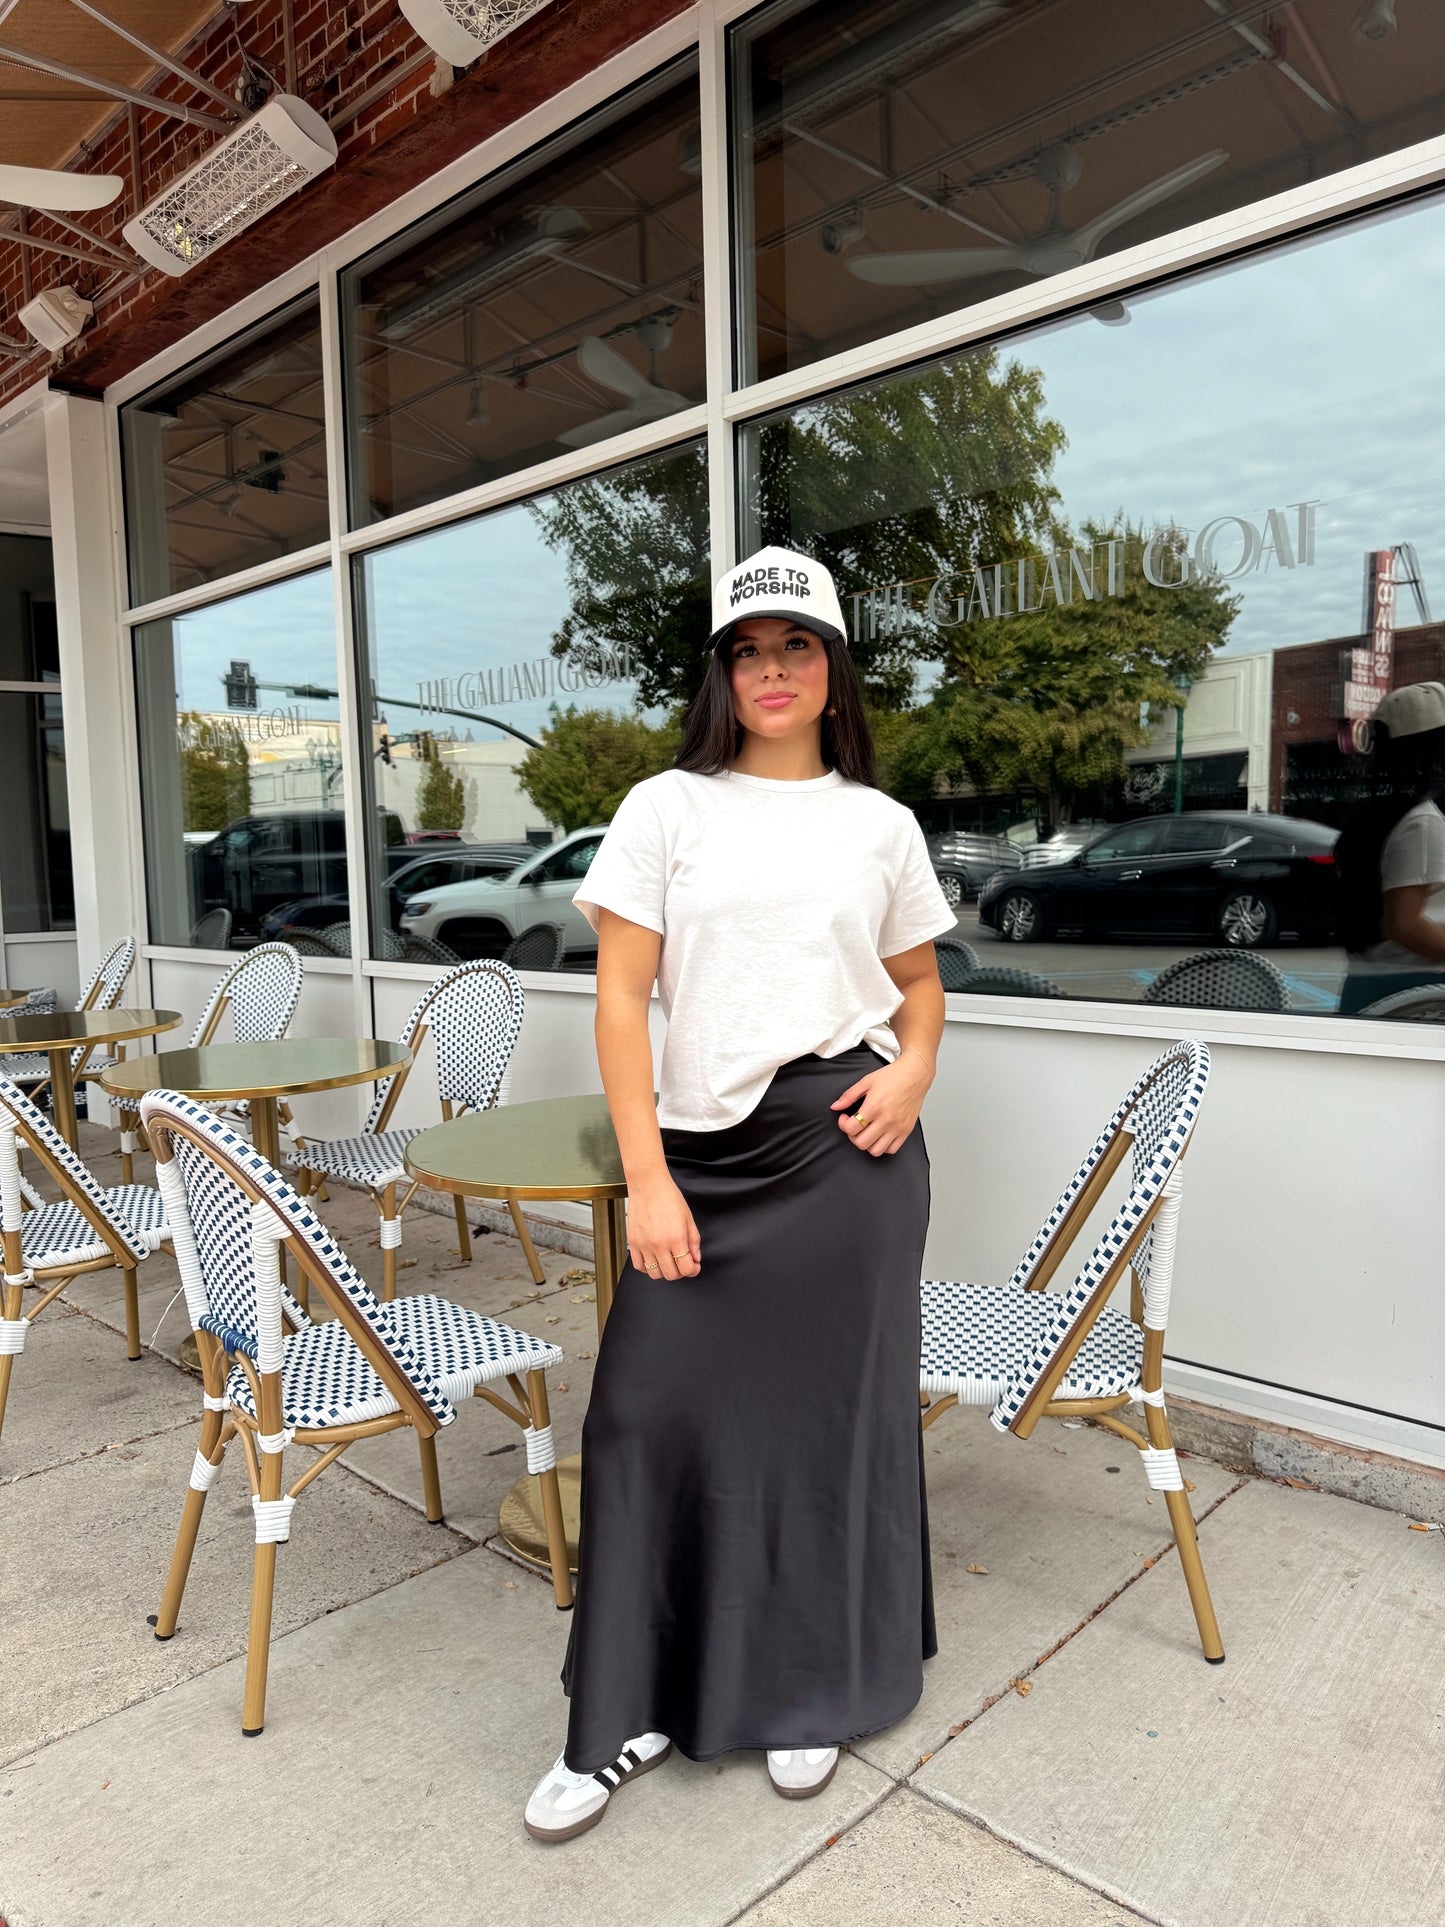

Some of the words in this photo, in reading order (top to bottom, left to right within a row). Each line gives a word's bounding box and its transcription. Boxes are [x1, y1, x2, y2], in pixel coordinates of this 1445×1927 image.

[732, 567, 779, 592] MADE
[785, 568, 809, 585] TO
[846, 585, 914, 643] THE
[927, 538, 1127, 627] GALLANT
[1143, 499, 1320, 589] GOAT
[730, 581, 811, 607] WORSHIP
[416, 677, 451, 716] THE
[457, 657, 550, 709] GALLANT
[557, 641, 635, 692] GOAT
[257, 704, 301, 741] GOAT
